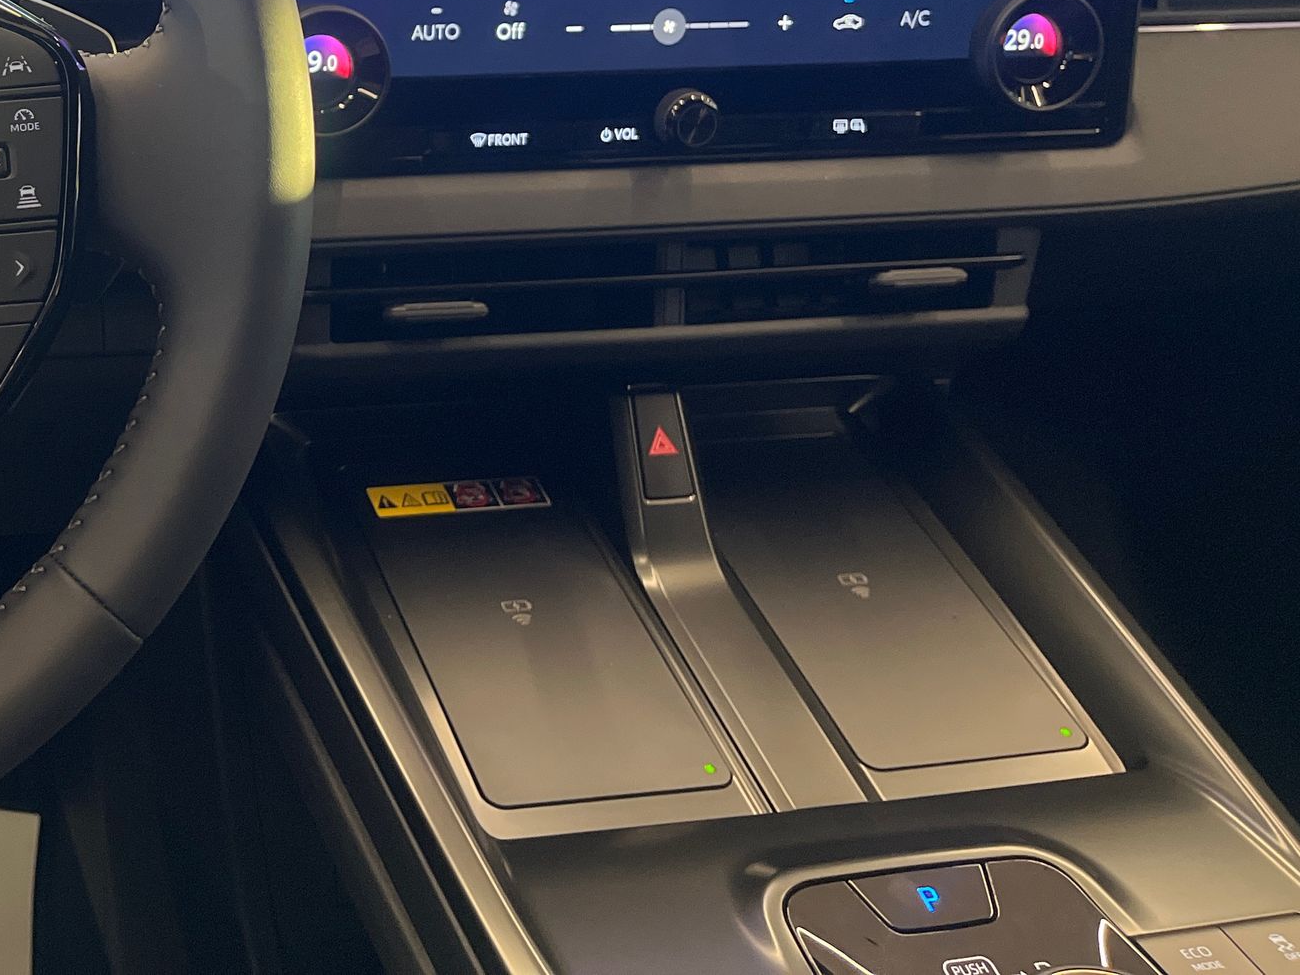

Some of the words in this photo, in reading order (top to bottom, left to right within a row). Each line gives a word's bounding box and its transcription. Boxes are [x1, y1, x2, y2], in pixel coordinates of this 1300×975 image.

[900, 9, 931, 30] A/C
[410, 23, 461, 42] AUTO
[496, 22, 527, 41] Off
[1003, 28, 1045, 52] 29.0
[307, 50, 338, 74] 9.0
[9, 120, 41, 133] MODE
[614, 127, 639, 142] VOL
[487, 132, 530, 147] FRONT
[915, 885, 941, 913] P
[1179, 946, 1213, 960] ECO
[950, 961, 990, 975] PUSH
[1190, 960, 1226, 973] MODE
